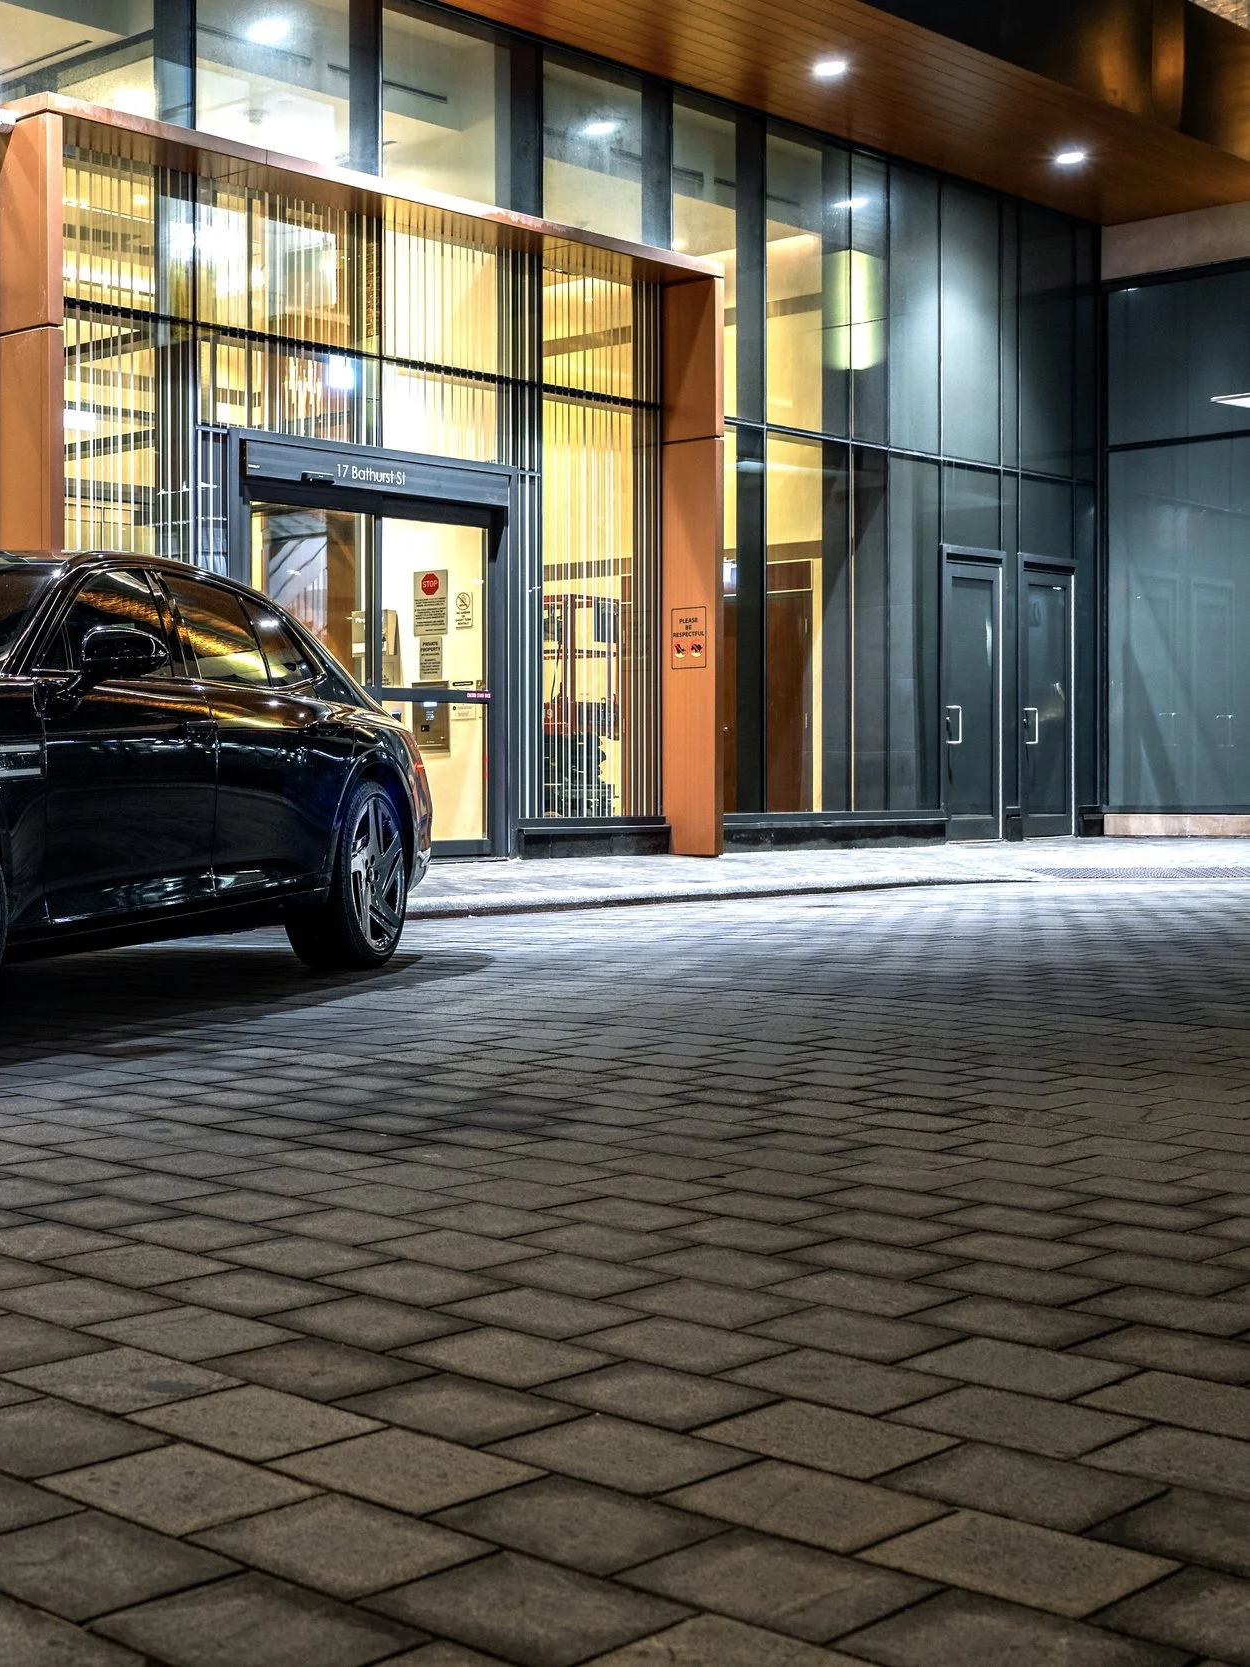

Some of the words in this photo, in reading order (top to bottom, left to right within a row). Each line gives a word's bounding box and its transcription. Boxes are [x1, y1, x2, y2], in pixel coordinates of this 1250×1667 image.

[337, 464, 349, 478] 17
[352, 466, 394, 484] Bathurst
[396, 472, 406, 486] St
[422, 580, 438, 588] STOP
